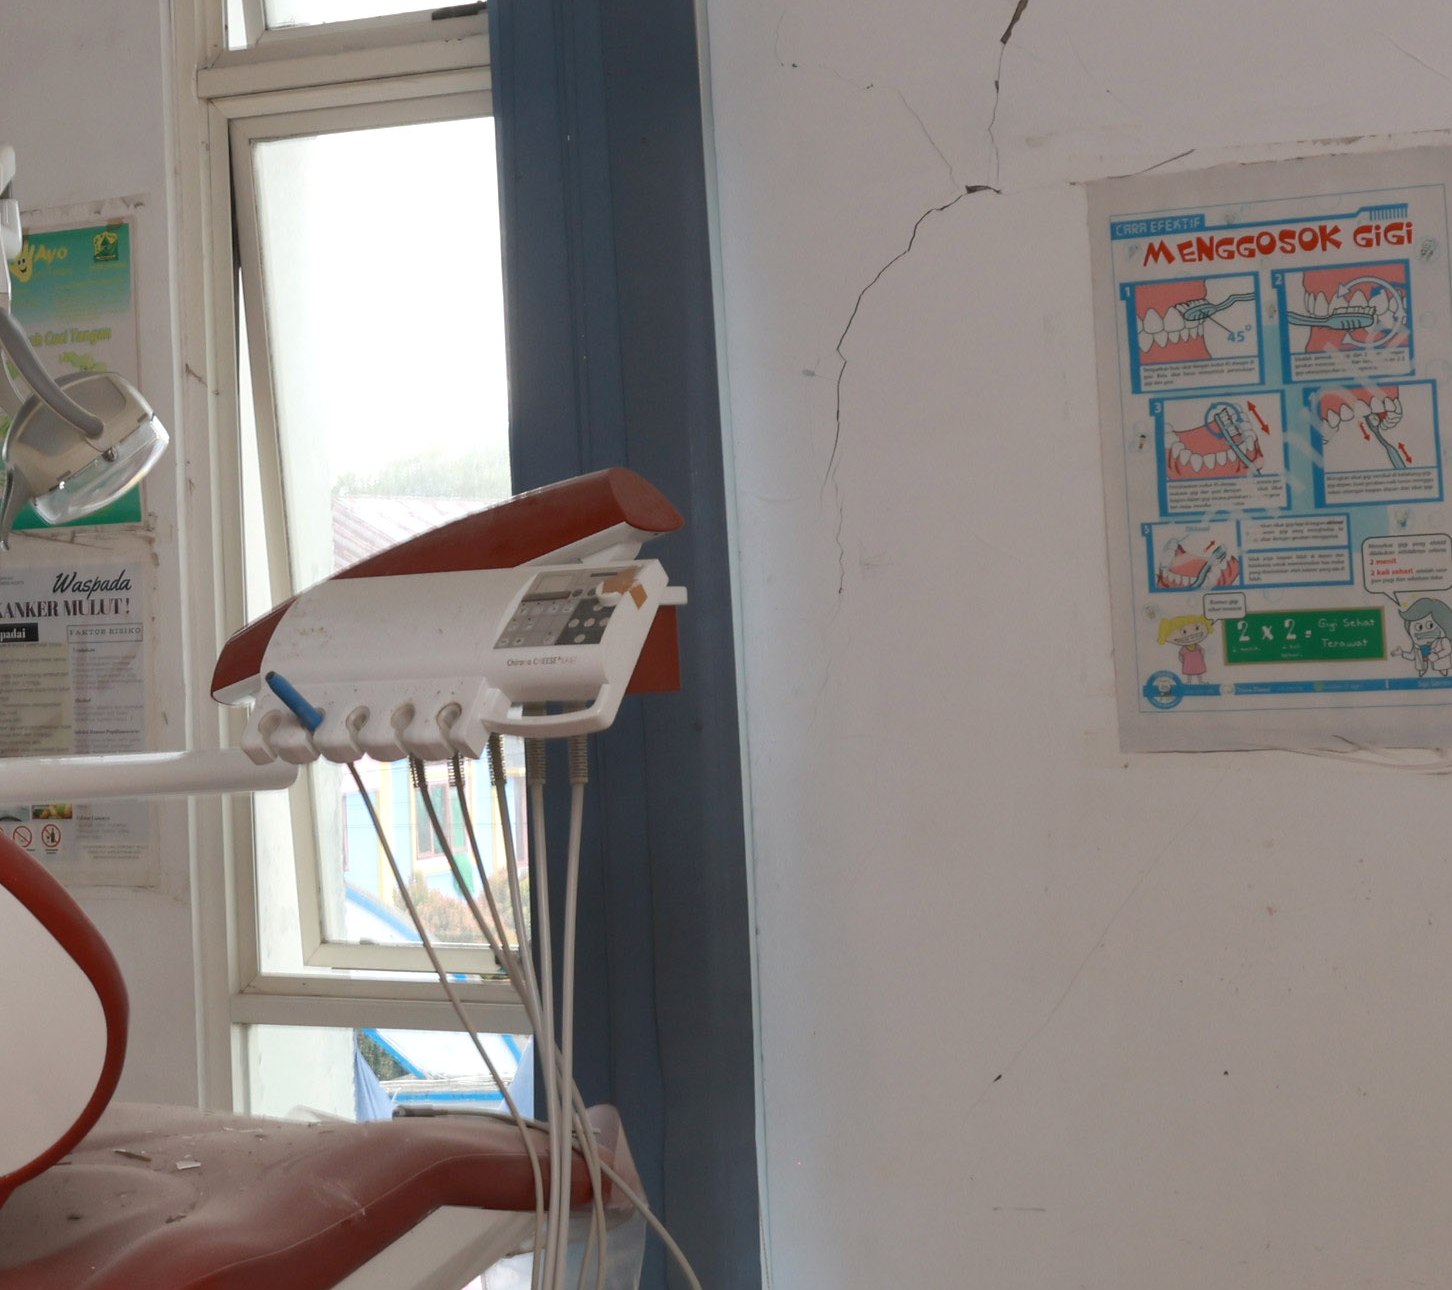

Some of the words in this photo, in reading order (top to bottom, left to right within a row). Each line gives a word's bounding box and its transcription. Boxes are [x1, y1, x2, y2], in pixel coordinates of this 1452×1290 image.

[1115, 221, 1148, 237] CARA
[1150, 216, 1201, 233] EFEKTIF
[34, 244, 68, 263] Ayo
[1143, 224, 1343, 267] MENGGOSOK
[1153, 401, 1162, 414] 3
[52, 568, 132, 600] Waspada
[63, 597, 123, 618] MULUT
[69, 628, 106, 637] FAKTOR
[108, 626, 142, 636] RISIKO
[1237, 620, 1250, 641] 2
[1283, 618, 1297, 640] 2
[1343, 618, 1375, 629] Sehat
[1321, 638, 1368, 648] Terawat
